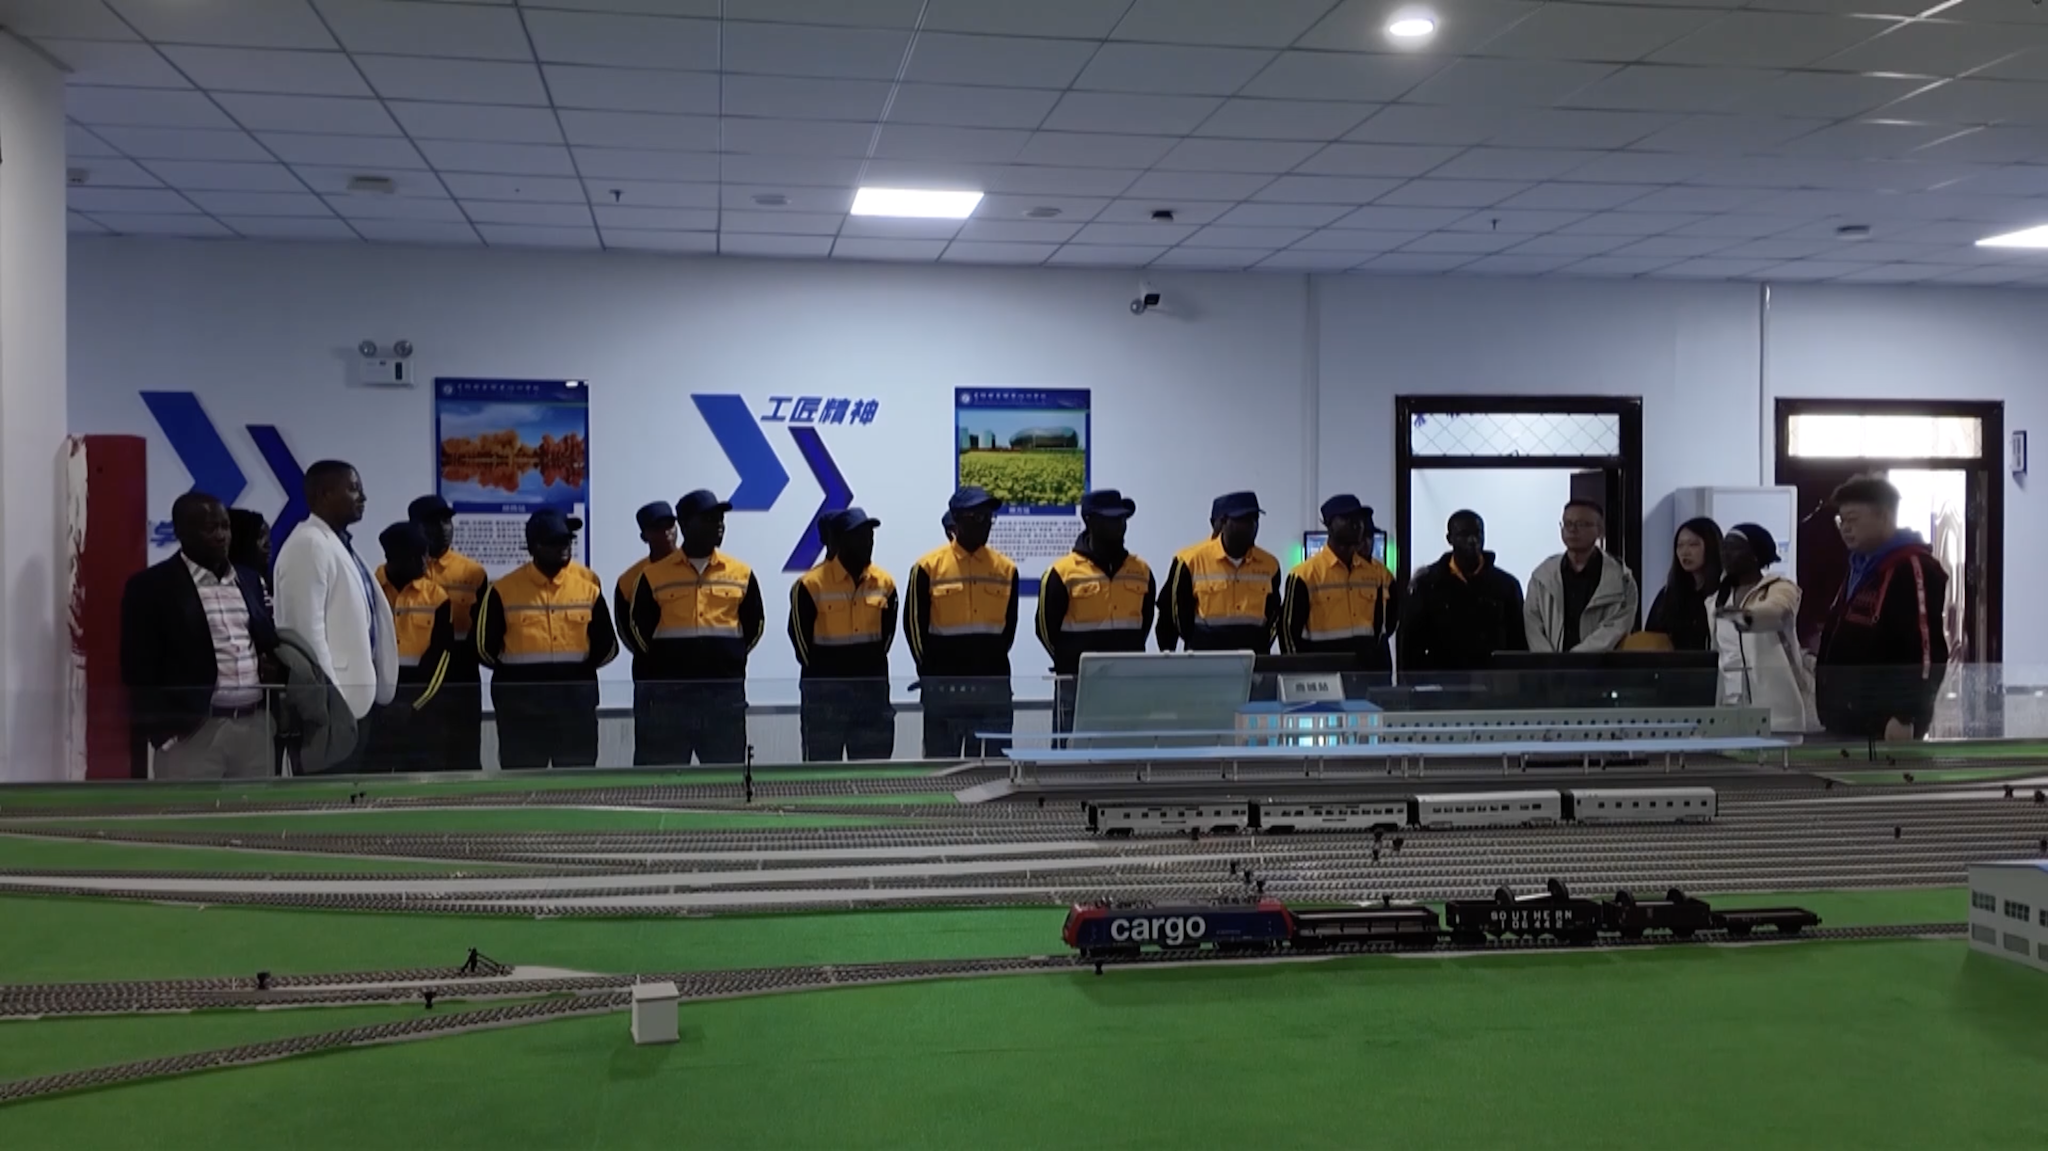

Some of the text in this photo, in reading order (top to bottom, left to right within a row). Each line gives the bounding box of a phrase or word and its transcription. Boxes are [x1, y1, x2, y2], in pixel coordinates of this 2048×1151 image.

[760, 396, 880, 426] 工匠精神
[1490, 909, 1573, 921] SOUTHERN
[1110, 915, 1207, 946] cargo
